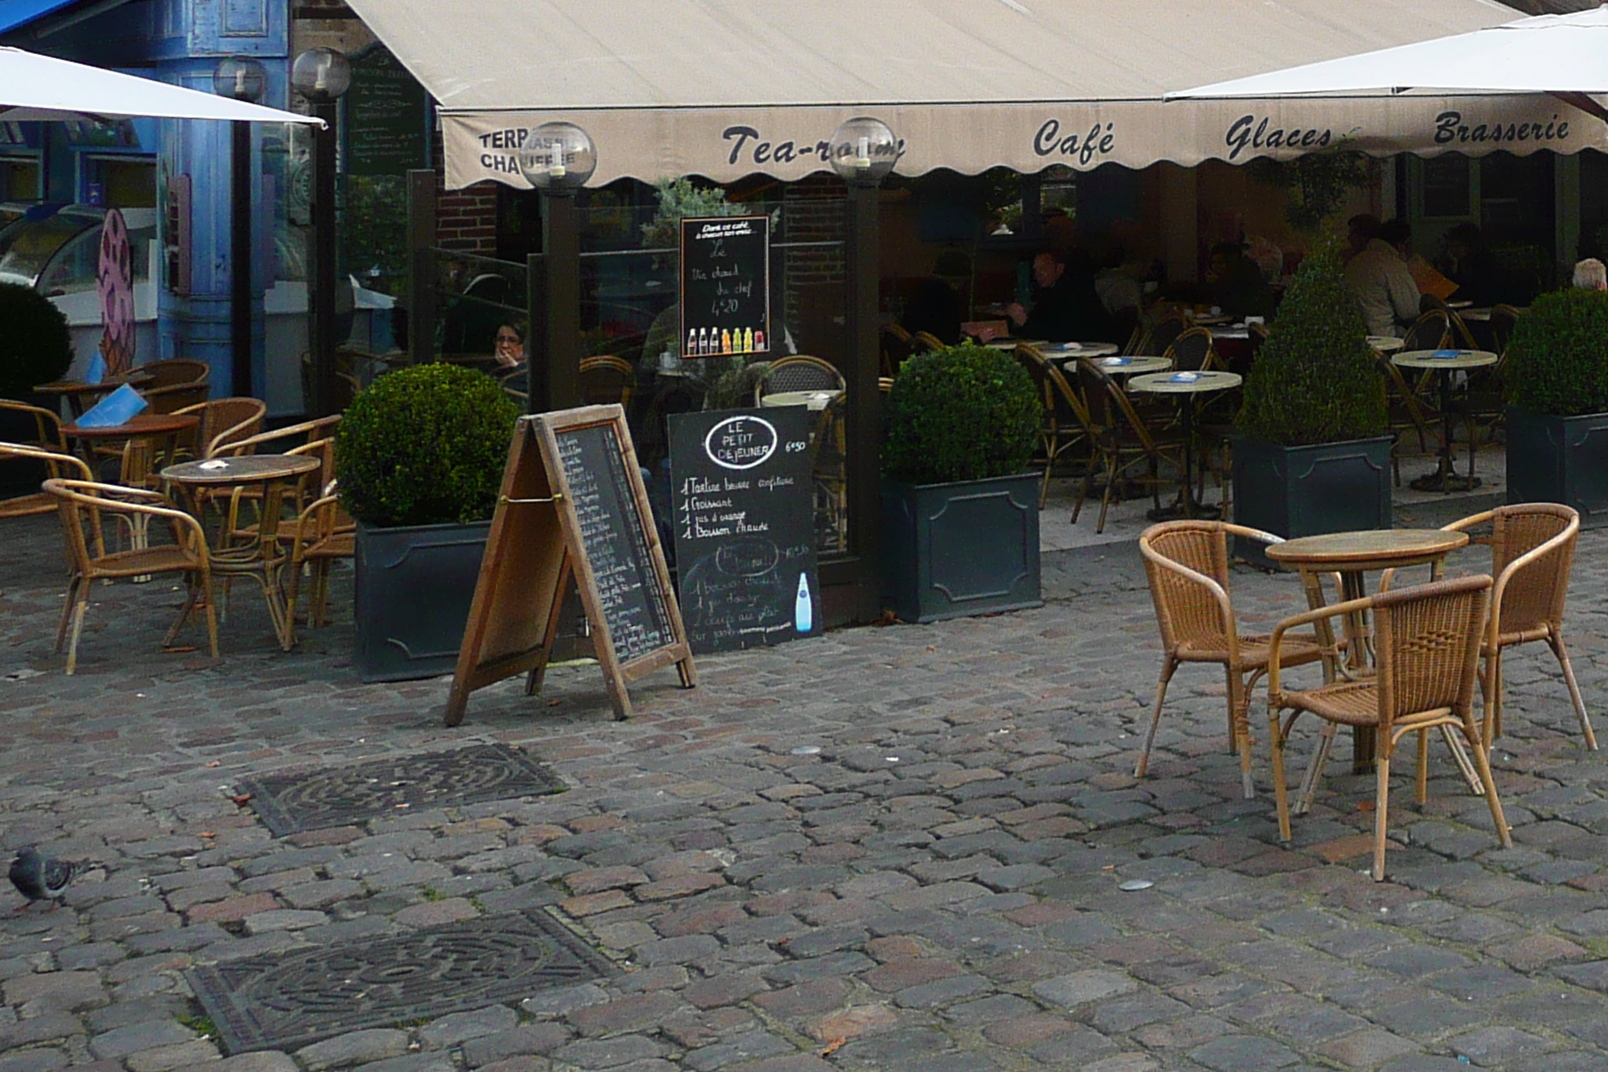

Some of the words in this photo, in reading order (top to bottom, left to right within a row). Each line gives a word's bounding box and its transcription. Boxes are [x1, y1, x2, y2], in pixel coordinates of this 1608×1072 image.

[1433, 111, 1569, 143] Brasserie
[1034, 119, 1114, 164] Café
[1226, 115, 1331, 160] Glaces
[734, 280, 752, 298] chef
[728, 421, 744, 433] LE
[722, 433, 753, 447] PETIT
[690, 476, 721, 493] Tartine
[724, 477, 750, 491] beurre
[757, 475, 795, 492] confiture
[691, 496, 733, 511] Croissant
